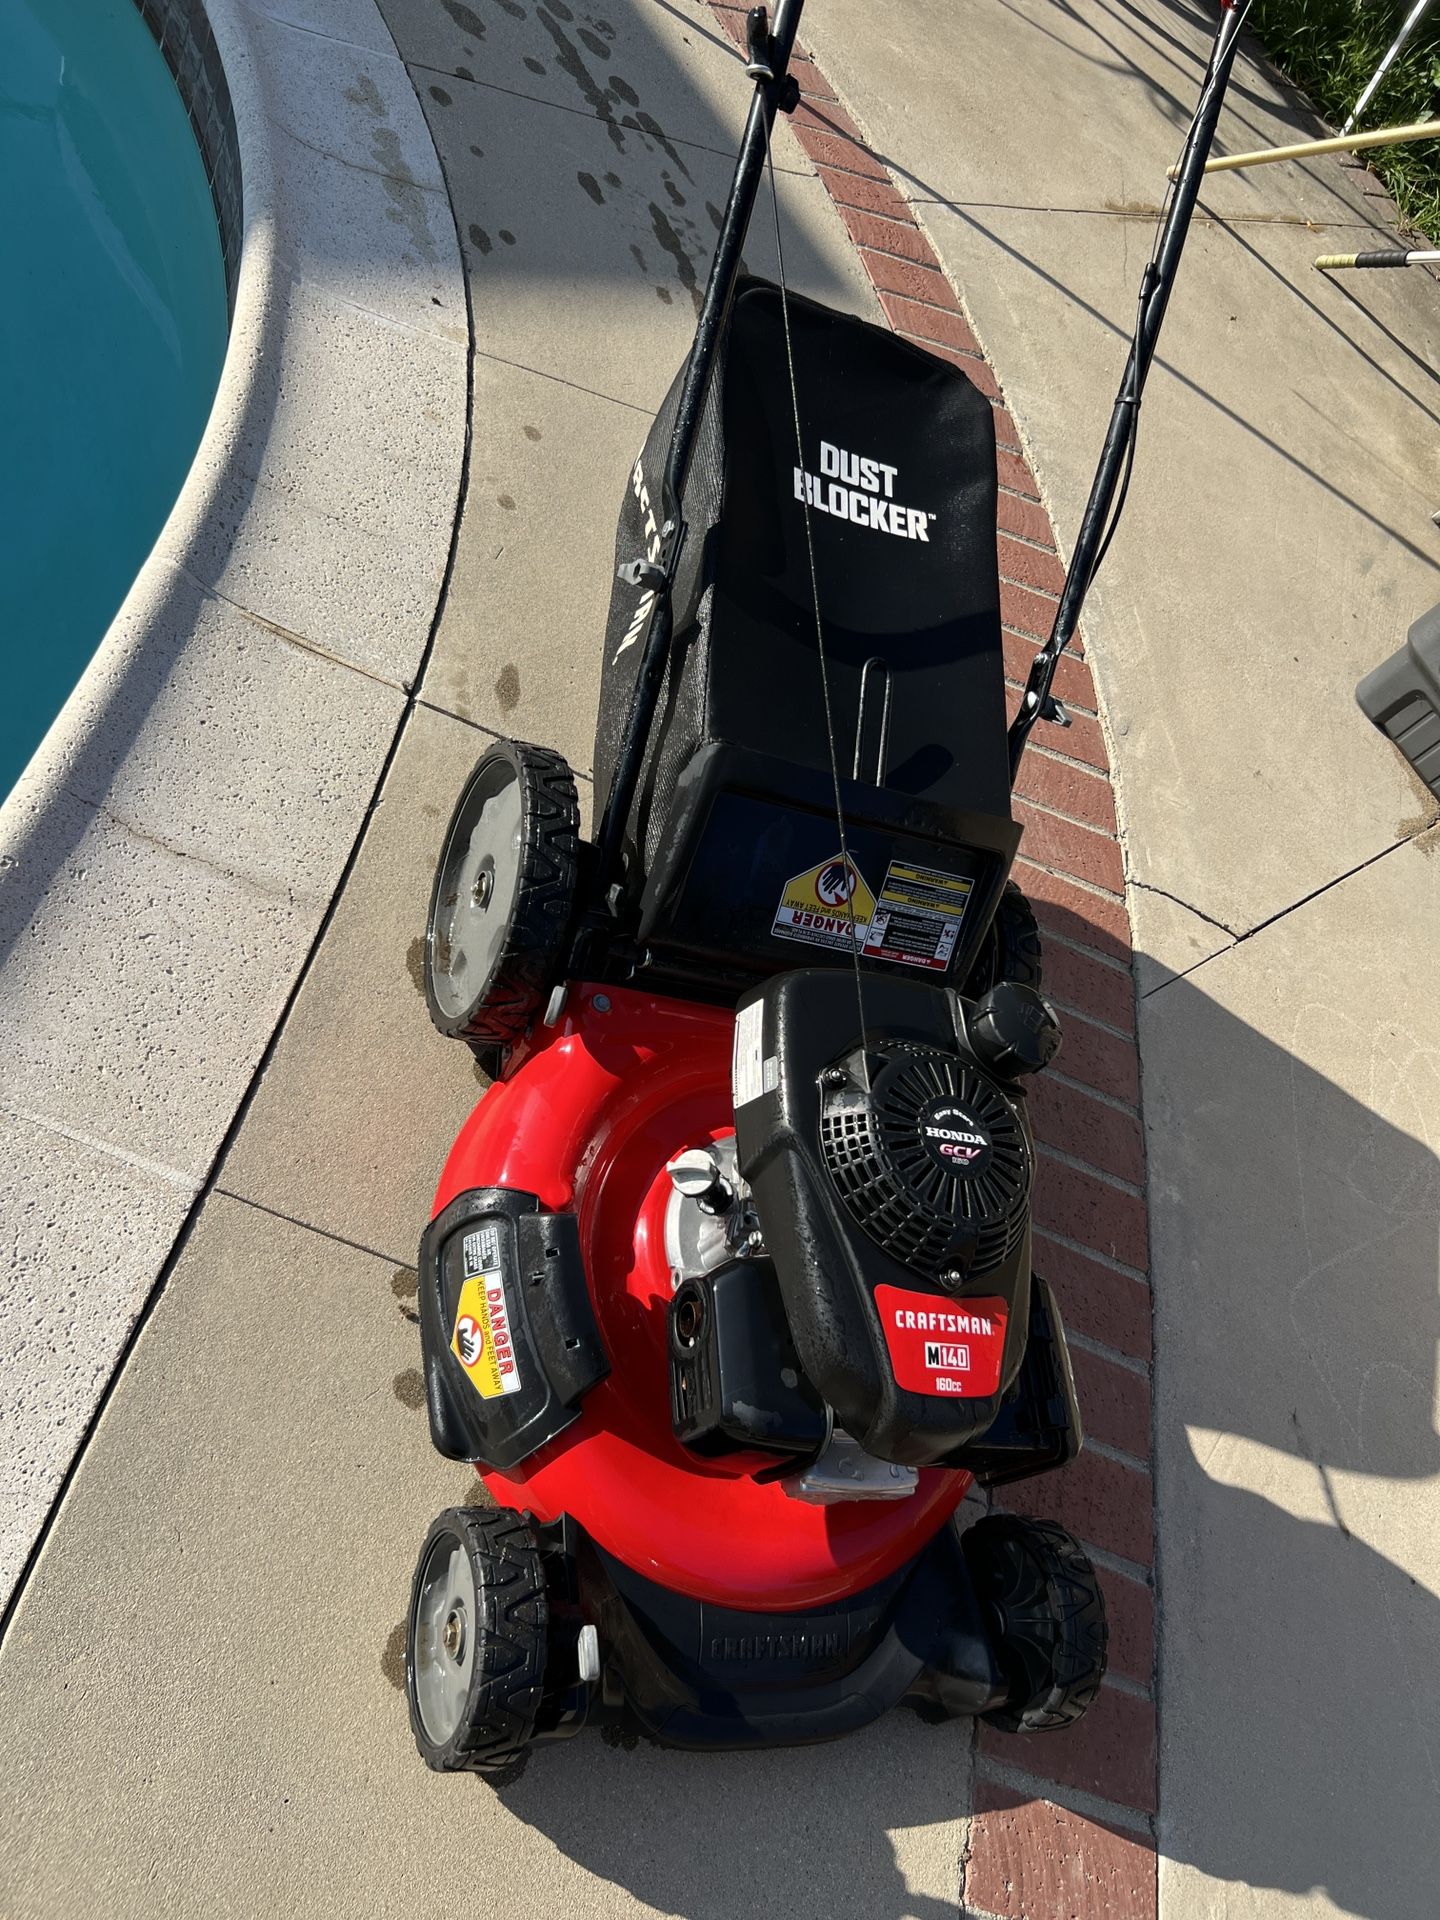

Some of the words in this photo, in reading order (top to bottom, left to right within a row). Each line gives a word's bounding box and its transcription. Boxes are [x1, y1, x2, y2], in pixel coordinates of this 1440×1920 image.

[820, 440, 897, 498] DUST
[914, 873, 943, 884] WARNING
[785, 898, 804, 908] AWAY
[805, 903, 819, 912] FEET
[907, 897, 935, 907] WARNING
[790, 910, 855, 935] DANGER
[925, 1126, 988, 1146] HONDA
[939, 1143, 981, 1159] GCV
[477, 1280, 486, 1302] KEEP
[481, 1303, 490, 1330] HANDS
[895, 1310, 992, 1335] CRAFTSMAN
[487, 1288, 514, 1375] DANGER
[487, 1345, 496, 1365] FEET
[927, 1345, 968, 1368] M140
[491, 1368, 502, 1390] AWAY
[711, 1634, 838, 1658] CRAFTSMAN
